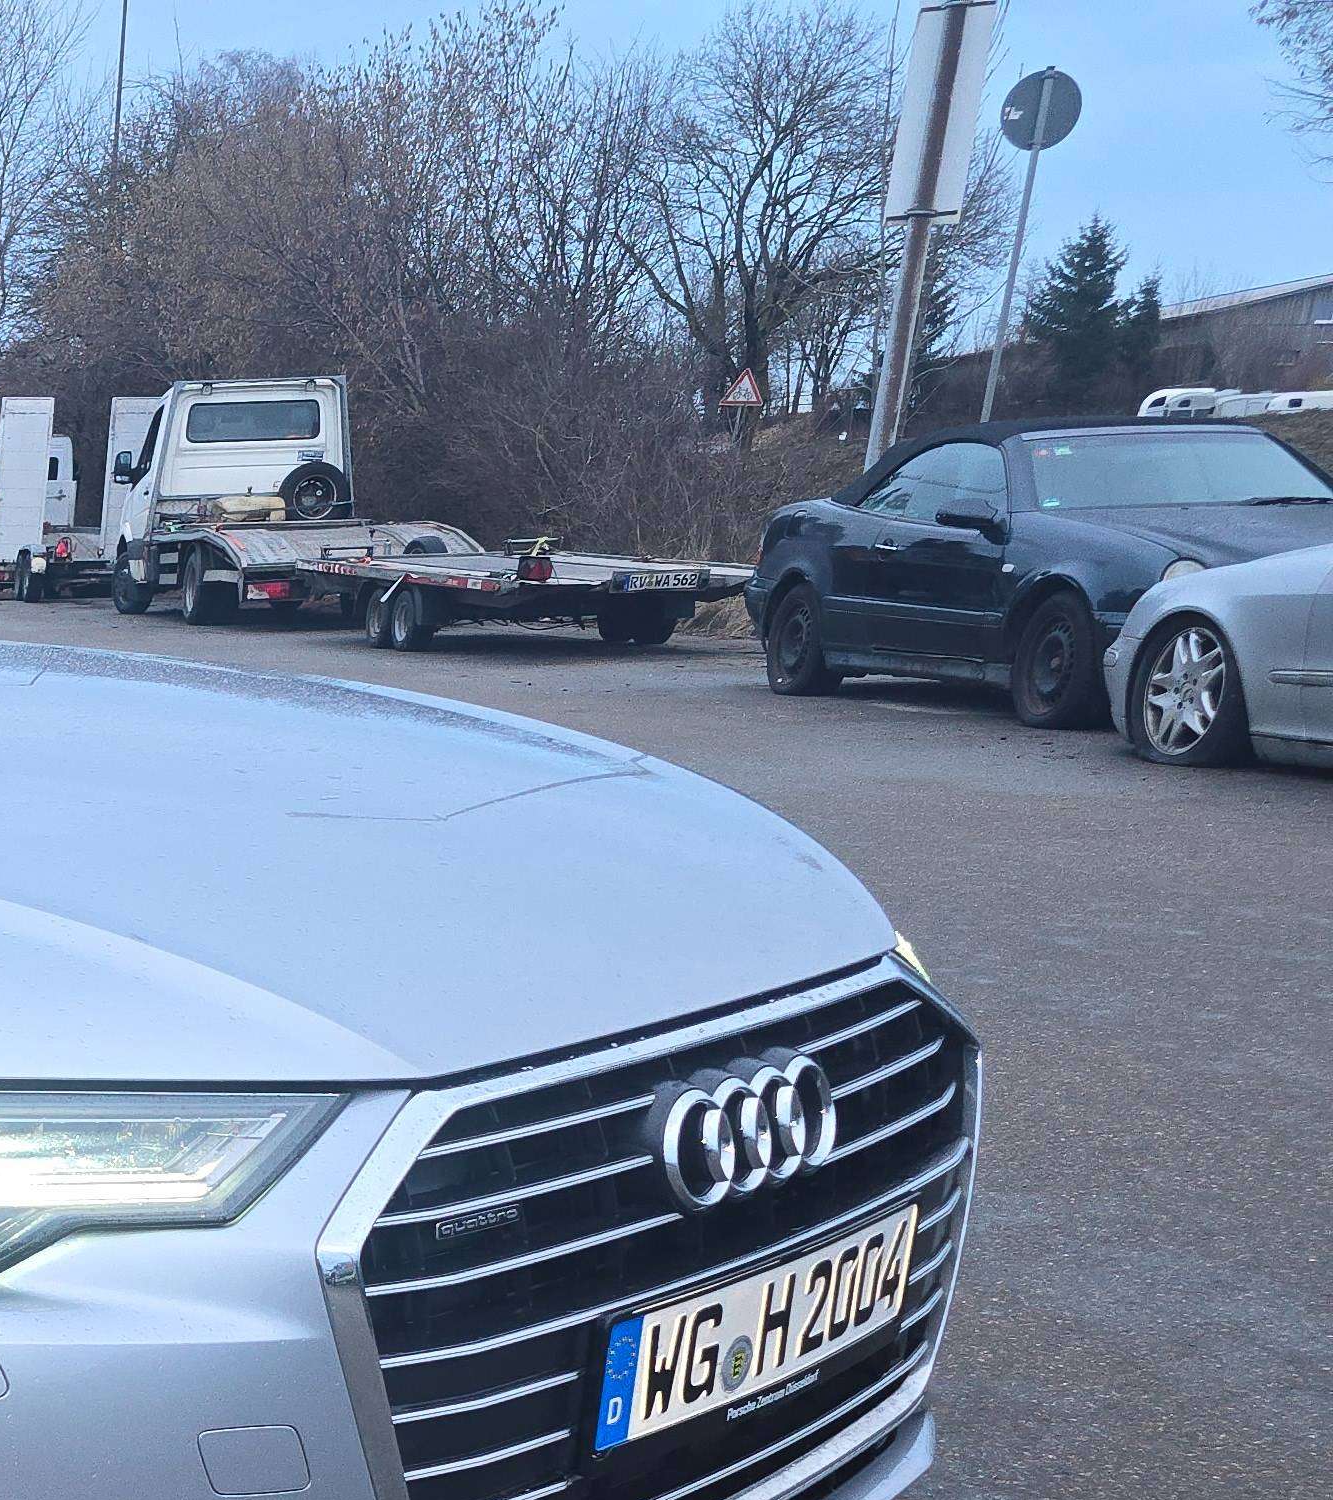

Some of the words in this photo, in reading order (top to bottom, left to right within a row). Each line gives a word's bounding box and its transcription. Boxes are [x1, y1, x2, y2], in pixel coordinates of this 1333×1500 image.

[630, 576, 648, 589] RV
[673, 573, 697, 587] 562
[441, 1208, 518, 1236] quattro
[642, 1302, 724, 1421] WG
[606, 1396, 623, 1425] D
[726, 1400, 757, 1421] Porsche
